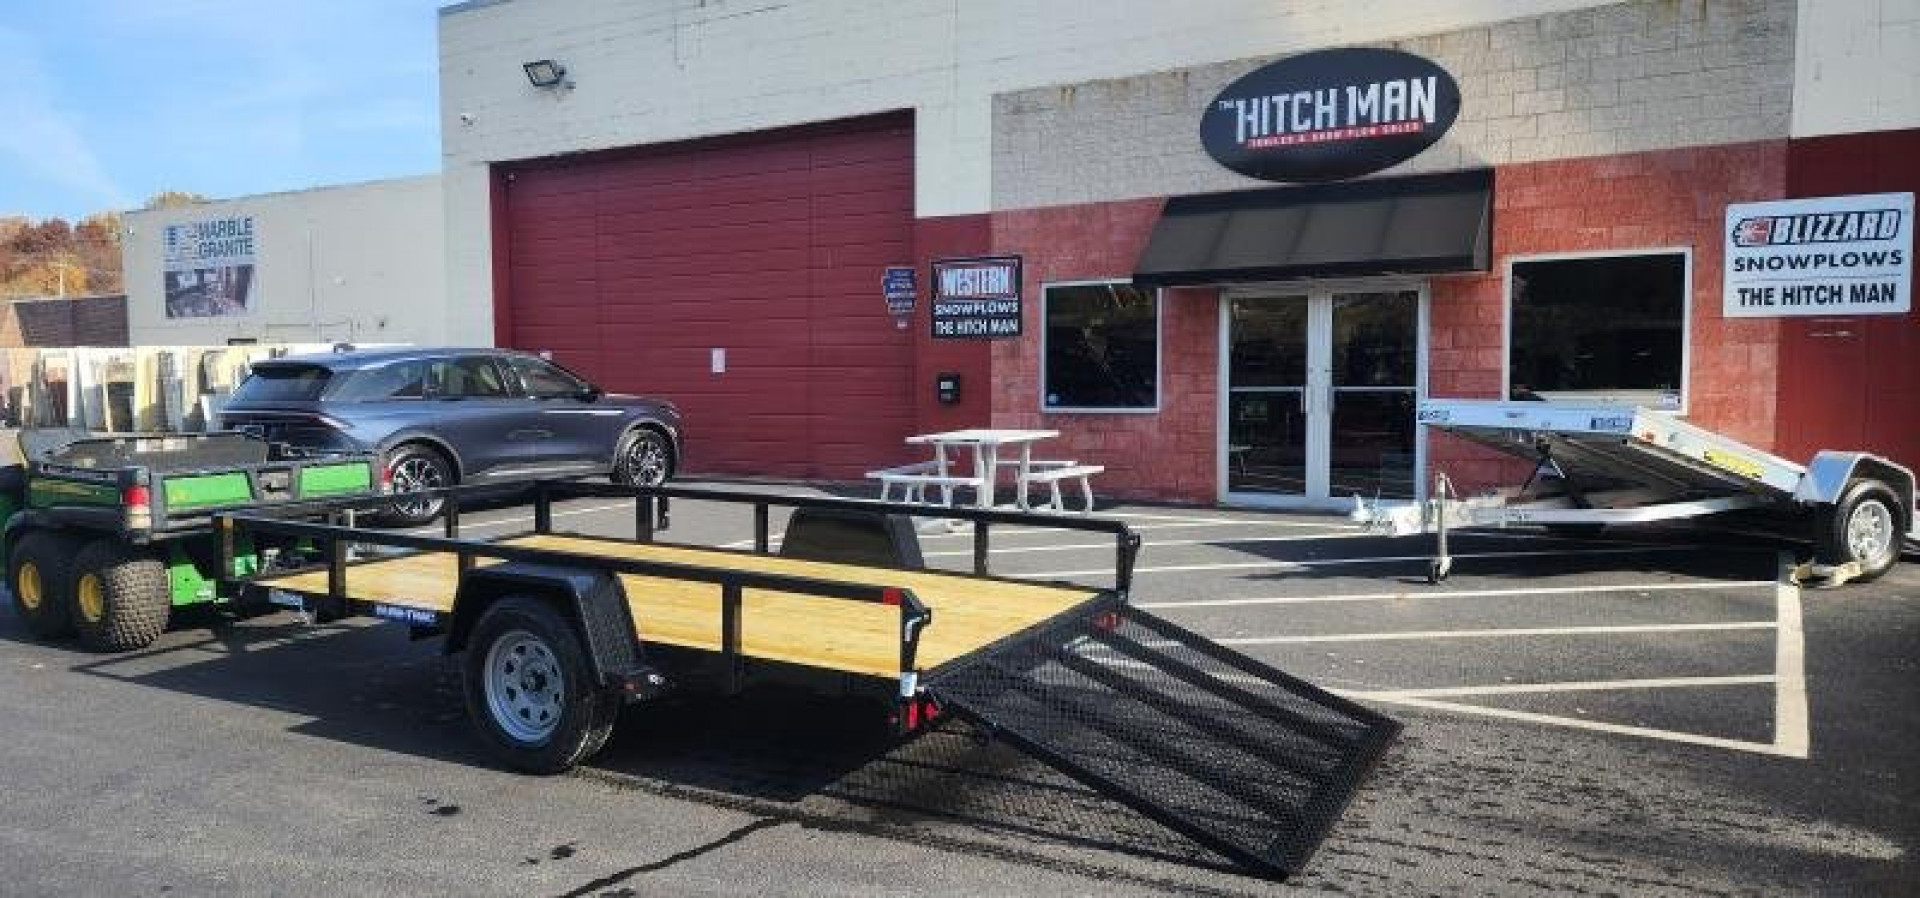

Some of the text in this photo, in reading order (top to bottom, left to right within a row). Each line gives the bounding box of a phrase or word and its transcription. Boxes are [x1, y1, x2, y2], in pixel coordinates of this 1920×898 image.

[1235, 88, 1339, 144] HITCH
[1346, 77, 1437, 125] MAN
[199, 217, 253, 239] MARBLE
[1771, 210, 1900, 244] BLIZZARD
[199, 238, 253, 259] GRANITE
[1733, 250, 1902, 272] SNOWPLOWS
[942, 266, 1009, 296] WESTERN
[1737, 282, 1897, 307] THE HITCH MAN
[935, 302, 1018, 316] SNOWPLOWS
[935, 318, 1018, 335] THE HITCH MAN
